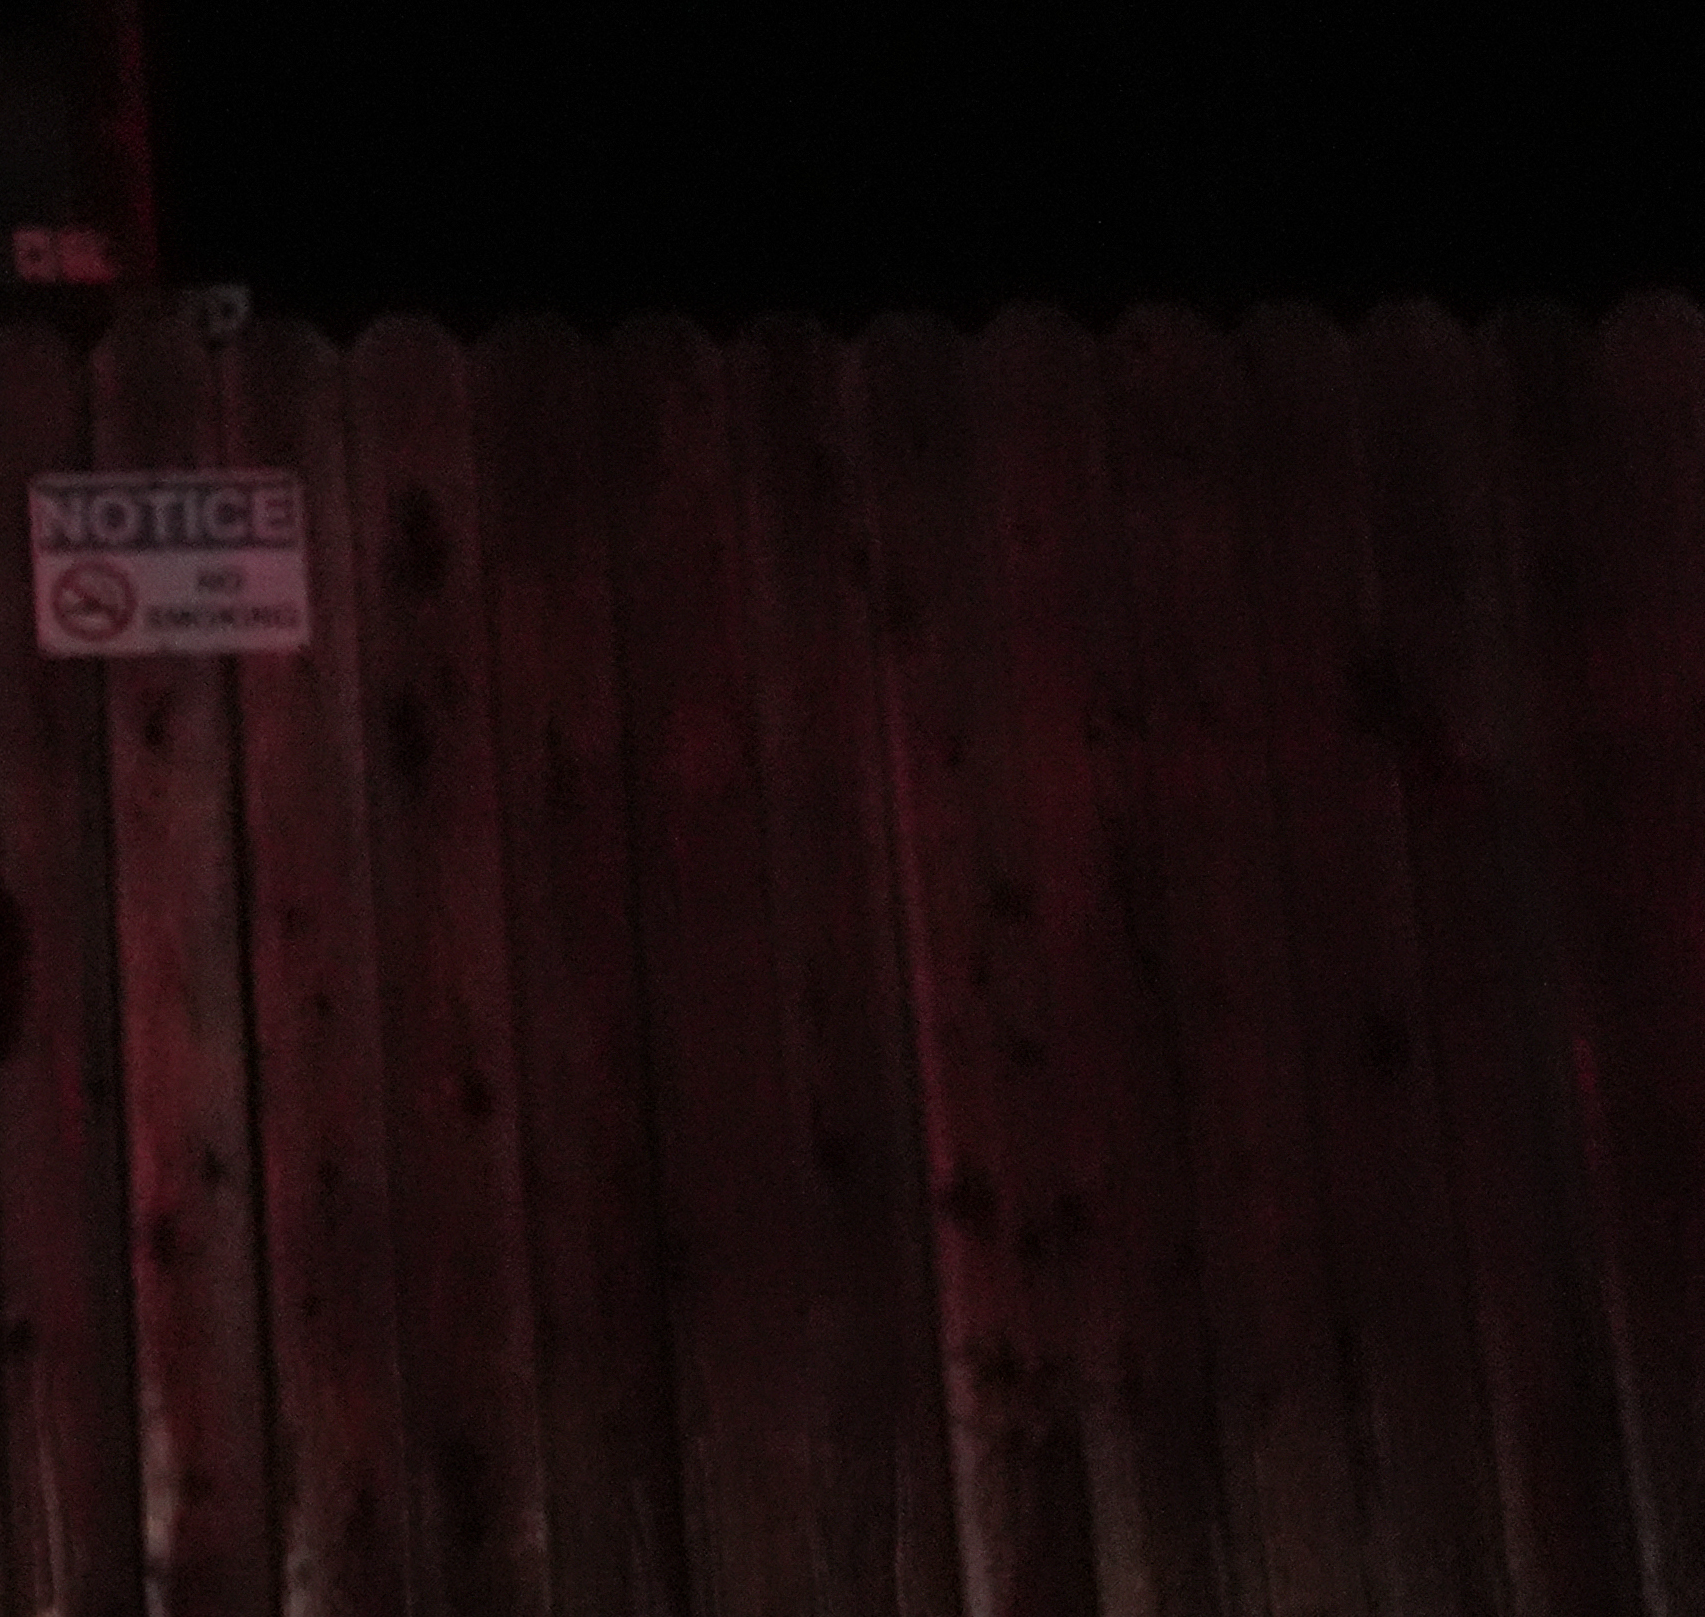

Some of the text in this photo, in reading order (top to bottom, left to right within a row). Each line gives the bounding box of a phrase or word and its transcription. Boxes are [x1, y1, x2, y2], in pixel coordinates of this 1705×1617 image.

[35, 489, 297, 544] NOTICE
[197, 569, 244, 591] NO
[146, 605, 297, 629] SMOKING
